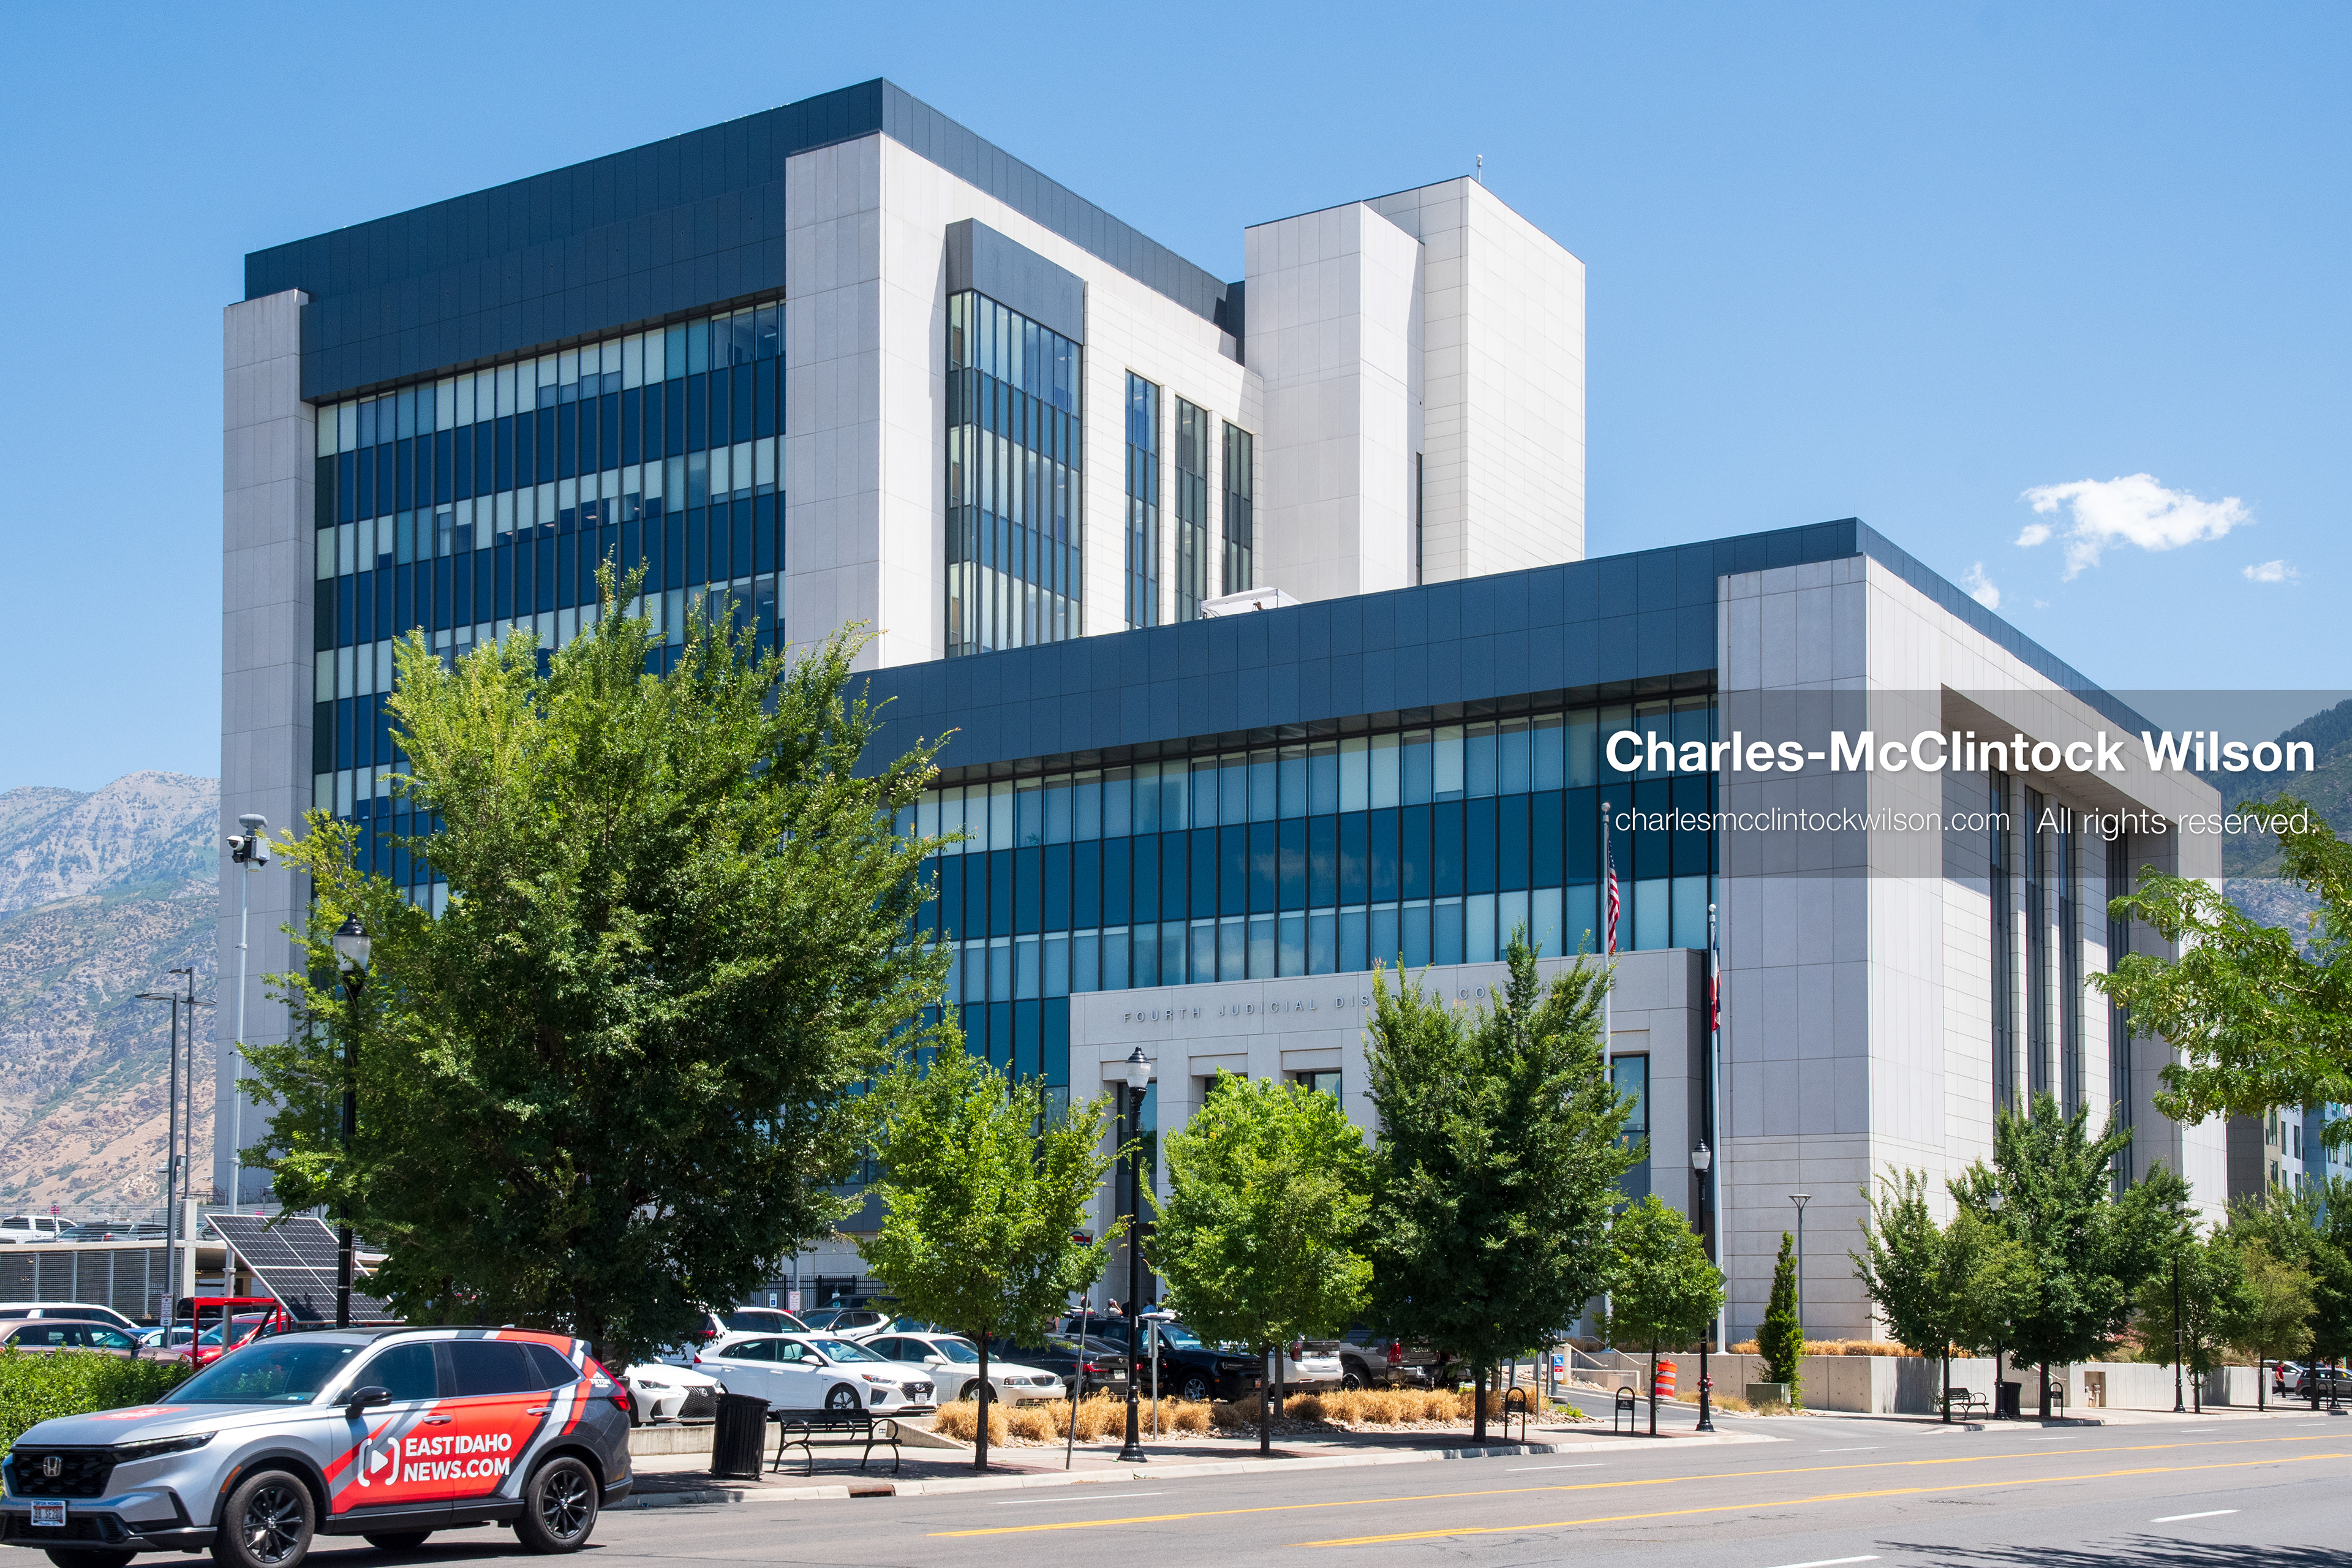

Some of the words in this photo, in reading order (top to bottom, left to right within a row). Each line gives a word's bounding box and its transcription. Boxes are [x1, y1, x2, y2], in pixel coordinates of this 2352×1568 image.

[1123, 1006, 1200, 1023] FOURTH
[1218, 999, 1317, 1016] JUDICIAL
[404, 1457, 511, 1482] NEWS.COM
